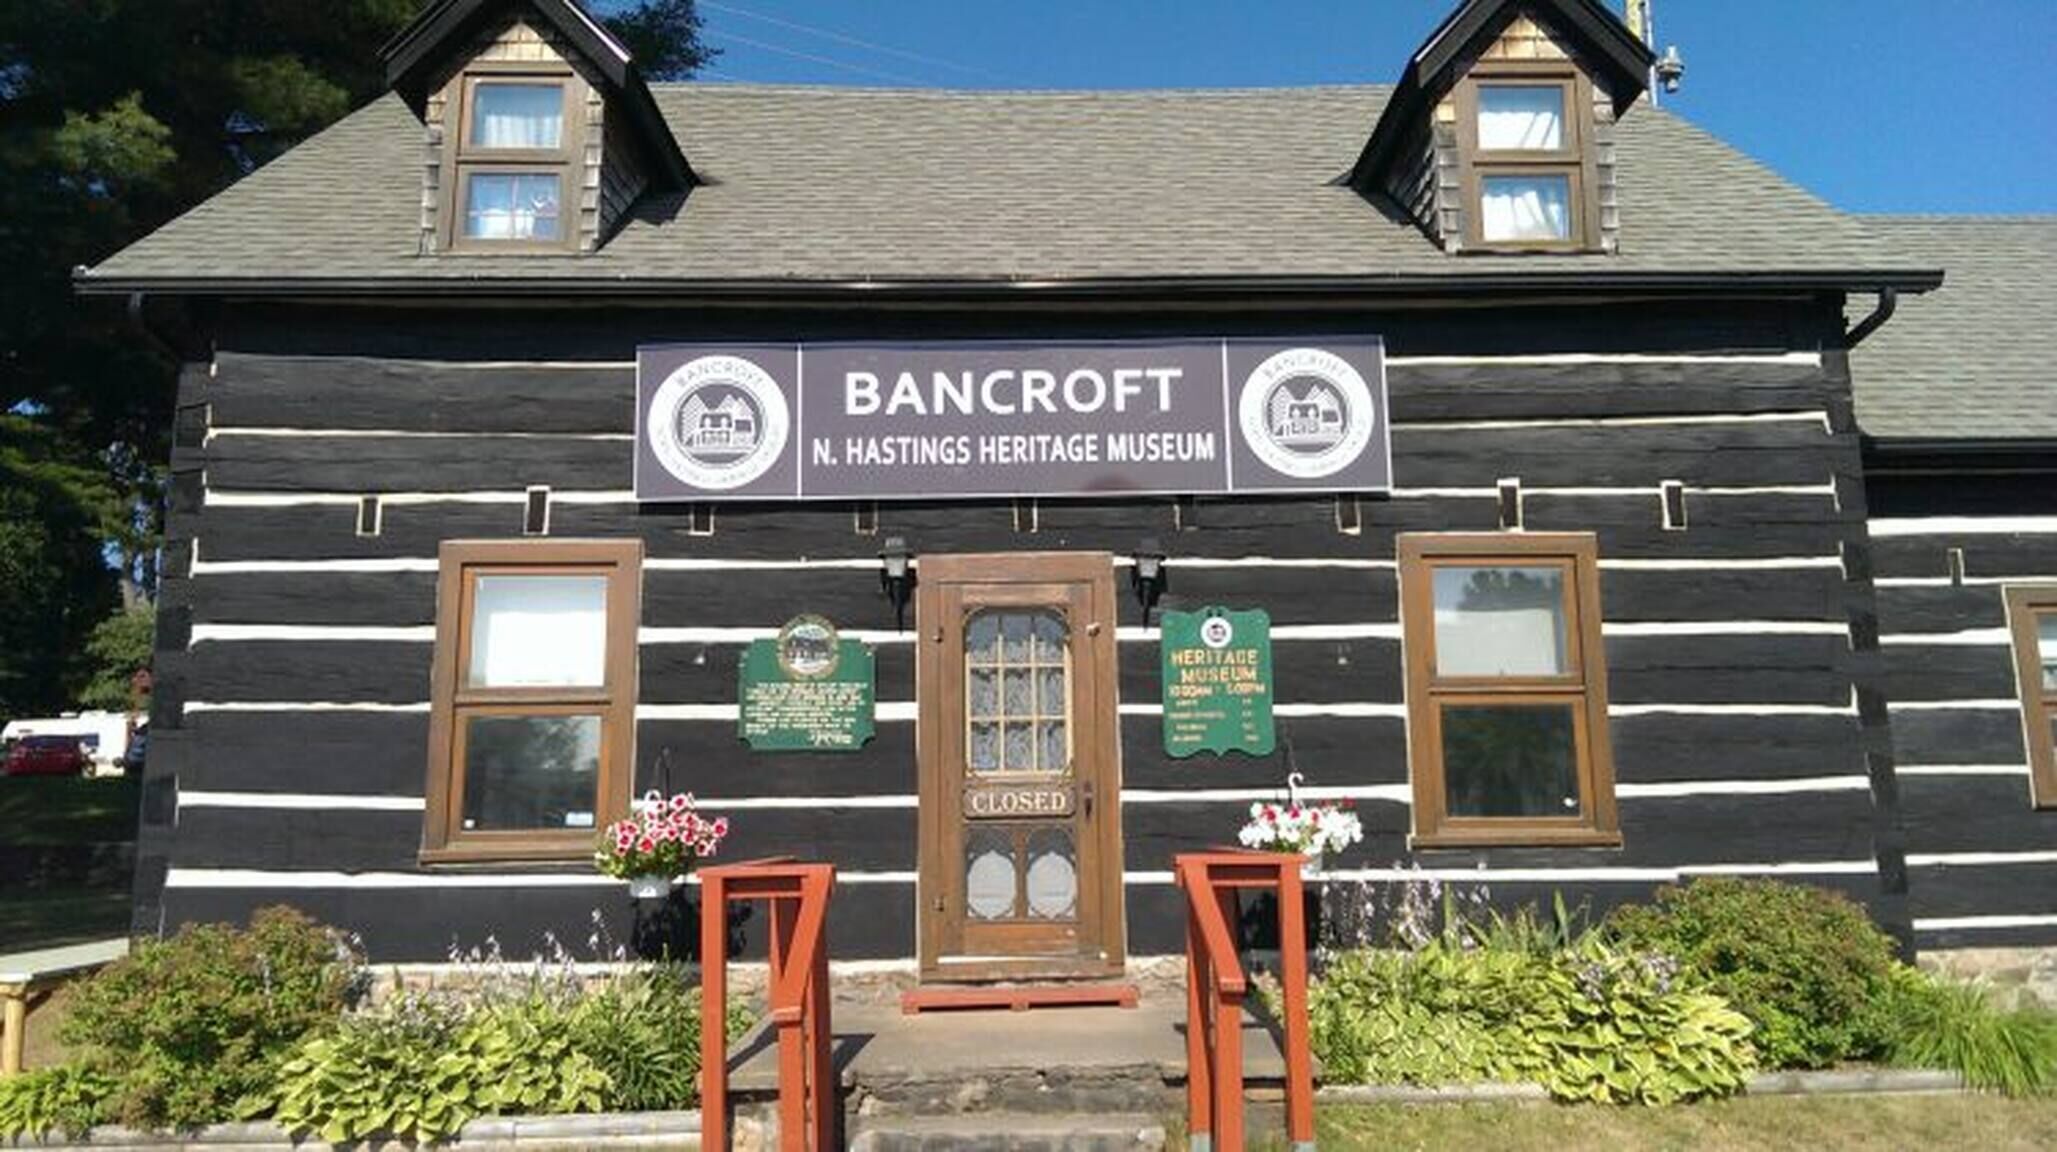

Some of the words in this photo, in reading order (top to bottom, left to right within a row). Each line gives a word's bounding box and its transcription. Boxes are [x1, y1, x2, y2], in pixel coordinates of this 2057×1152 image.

[846, 368, 1183, 415] BANCROFT
[813, 438, 837, 465] N.
[846, 436, 971, 465] HASTINGS
[979, 433, 1099, 464] HERITAGE
[1108, 432, 1215, 461] MUSEUM
[1171, 649, 1258, 666] HERITAGE
[1180, 666, 1258, 683] MUSEUM
[972, 791, 1066, 813] CLOSED
